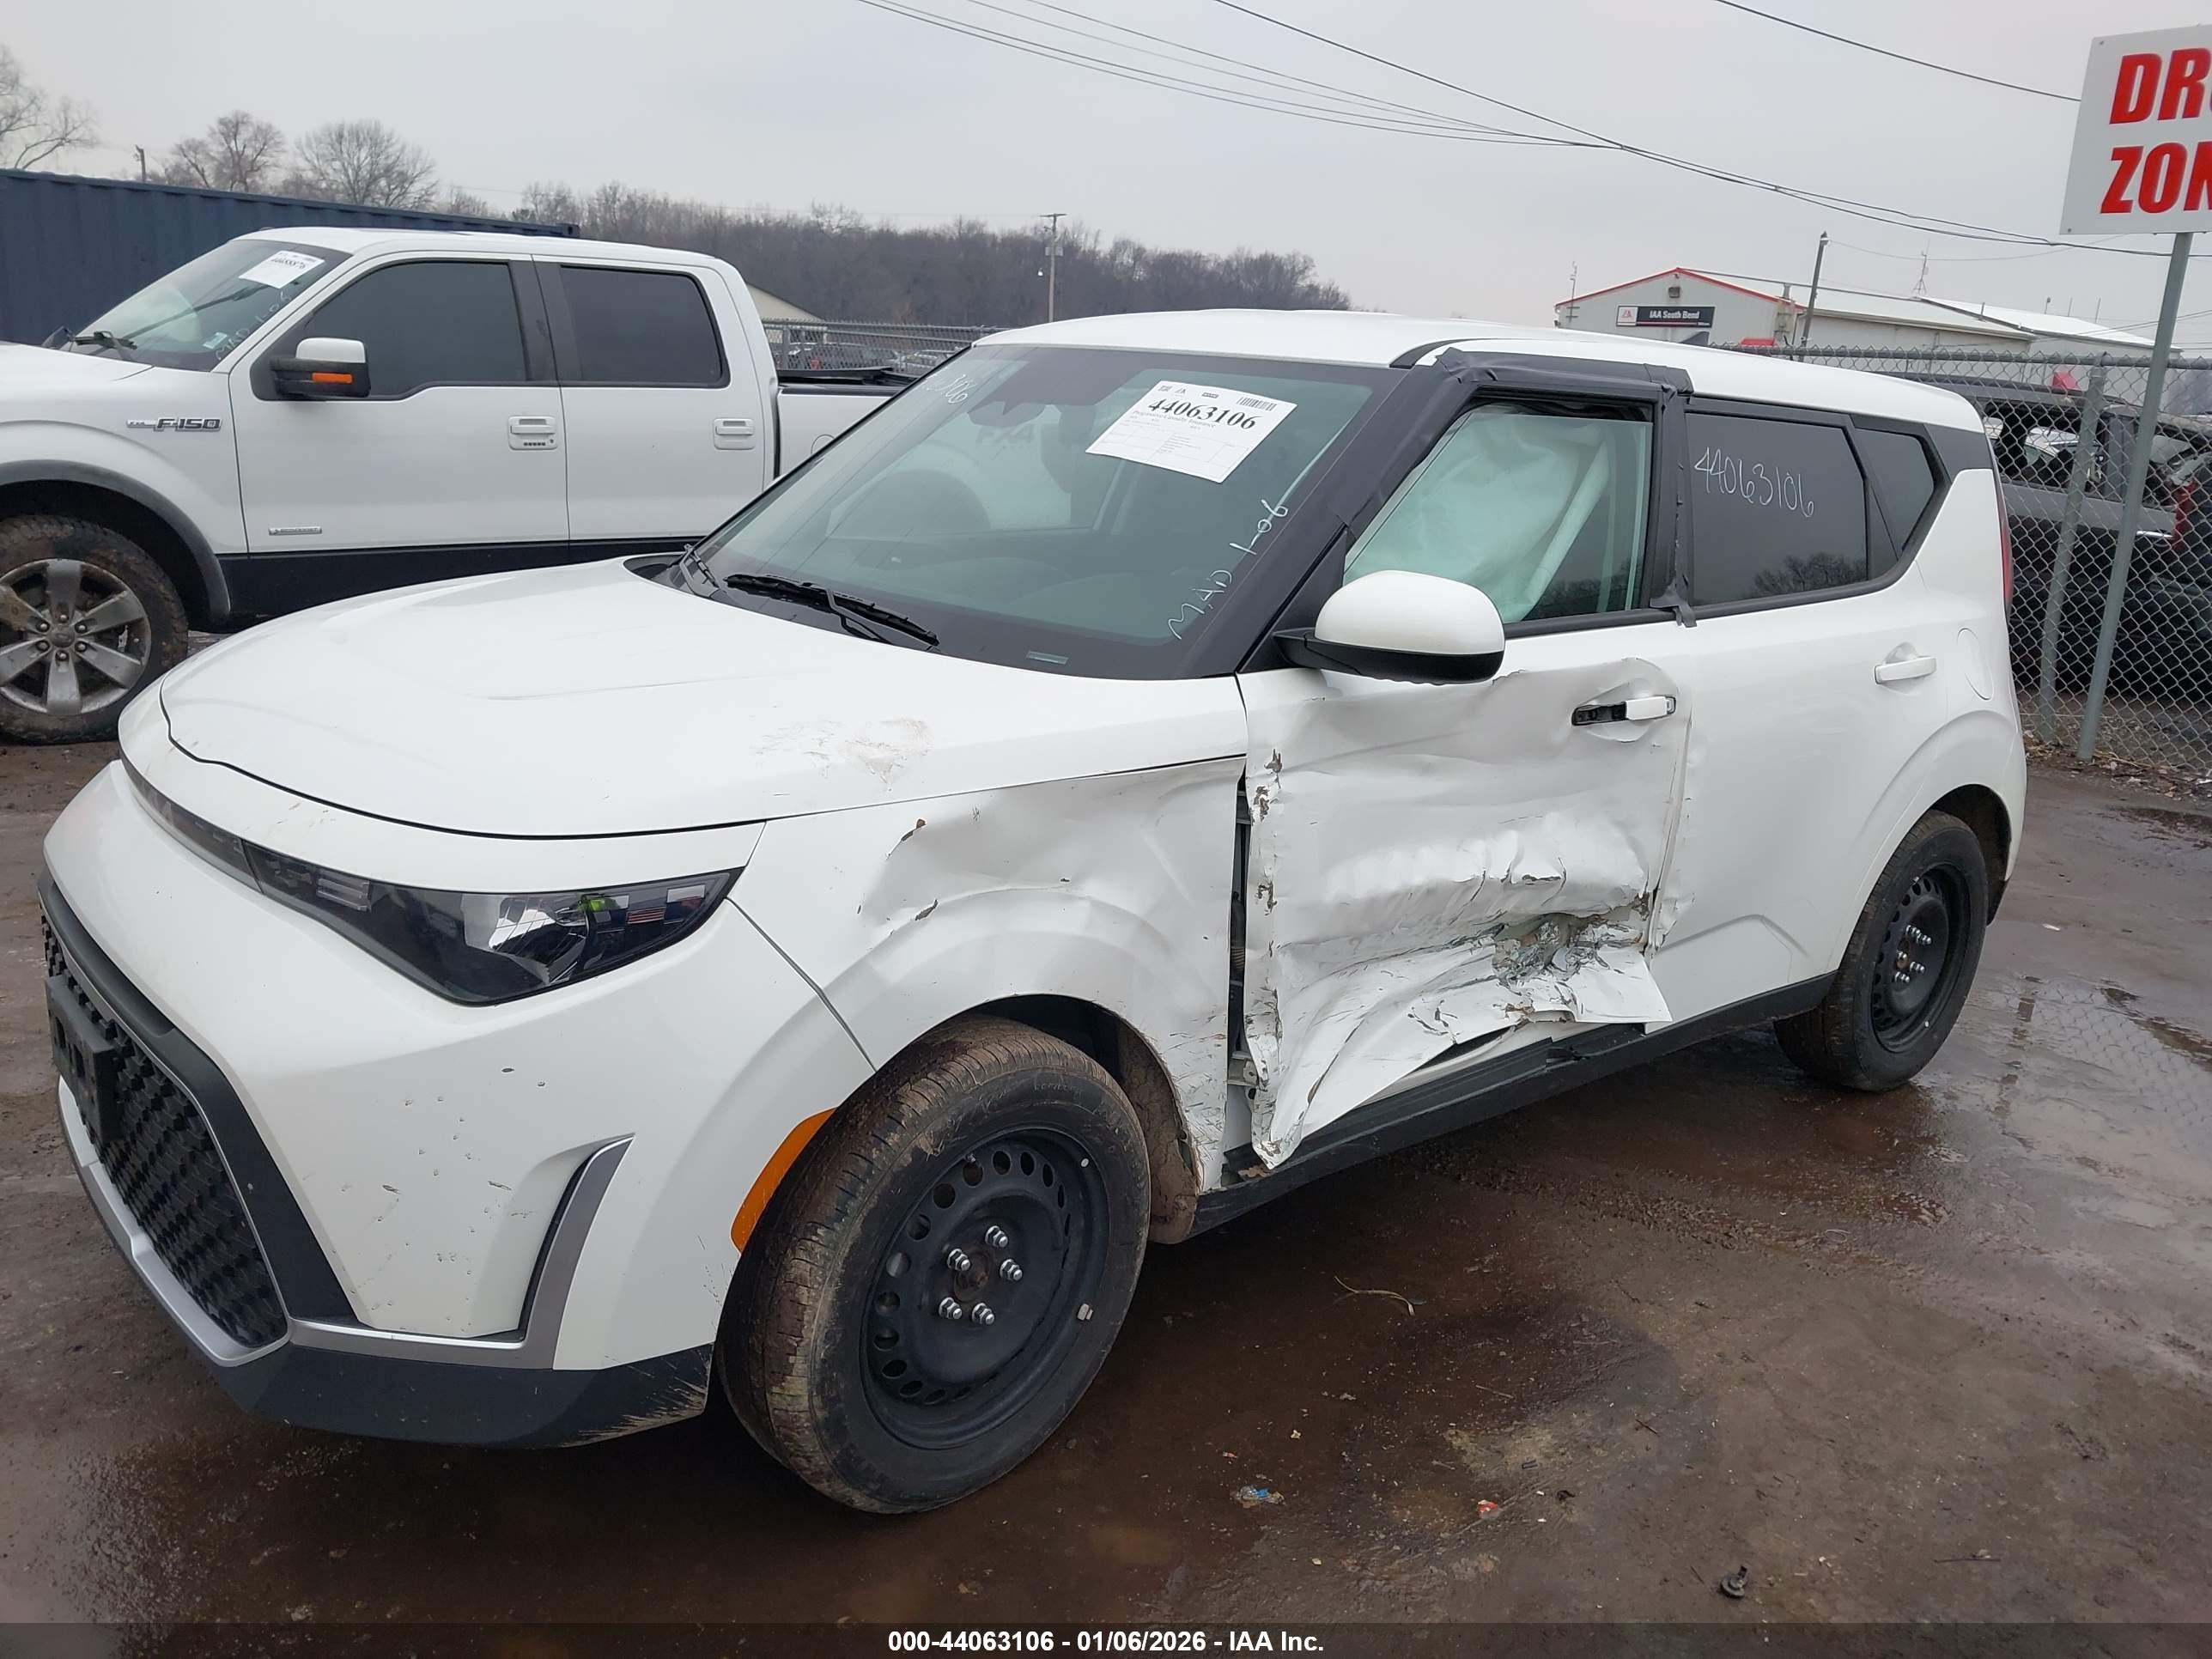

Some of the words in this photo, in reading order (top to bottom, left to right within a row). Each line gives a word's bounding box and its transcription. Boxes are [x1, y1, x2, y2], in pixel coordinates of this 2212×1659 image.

[2109, 47, 2212, 125] DR
[1649, 310, 1662, 319] IAA
[1662, 310, 1681, 319] South
[156, 418, 221, 429] F-150
[1148, 398, 1264, 429] 44063106
[1694, 447, 1814, 518] 44063106
[1168, 570, 1233, 640] MAD
[1229, 499, 1289, 556] 1-06
